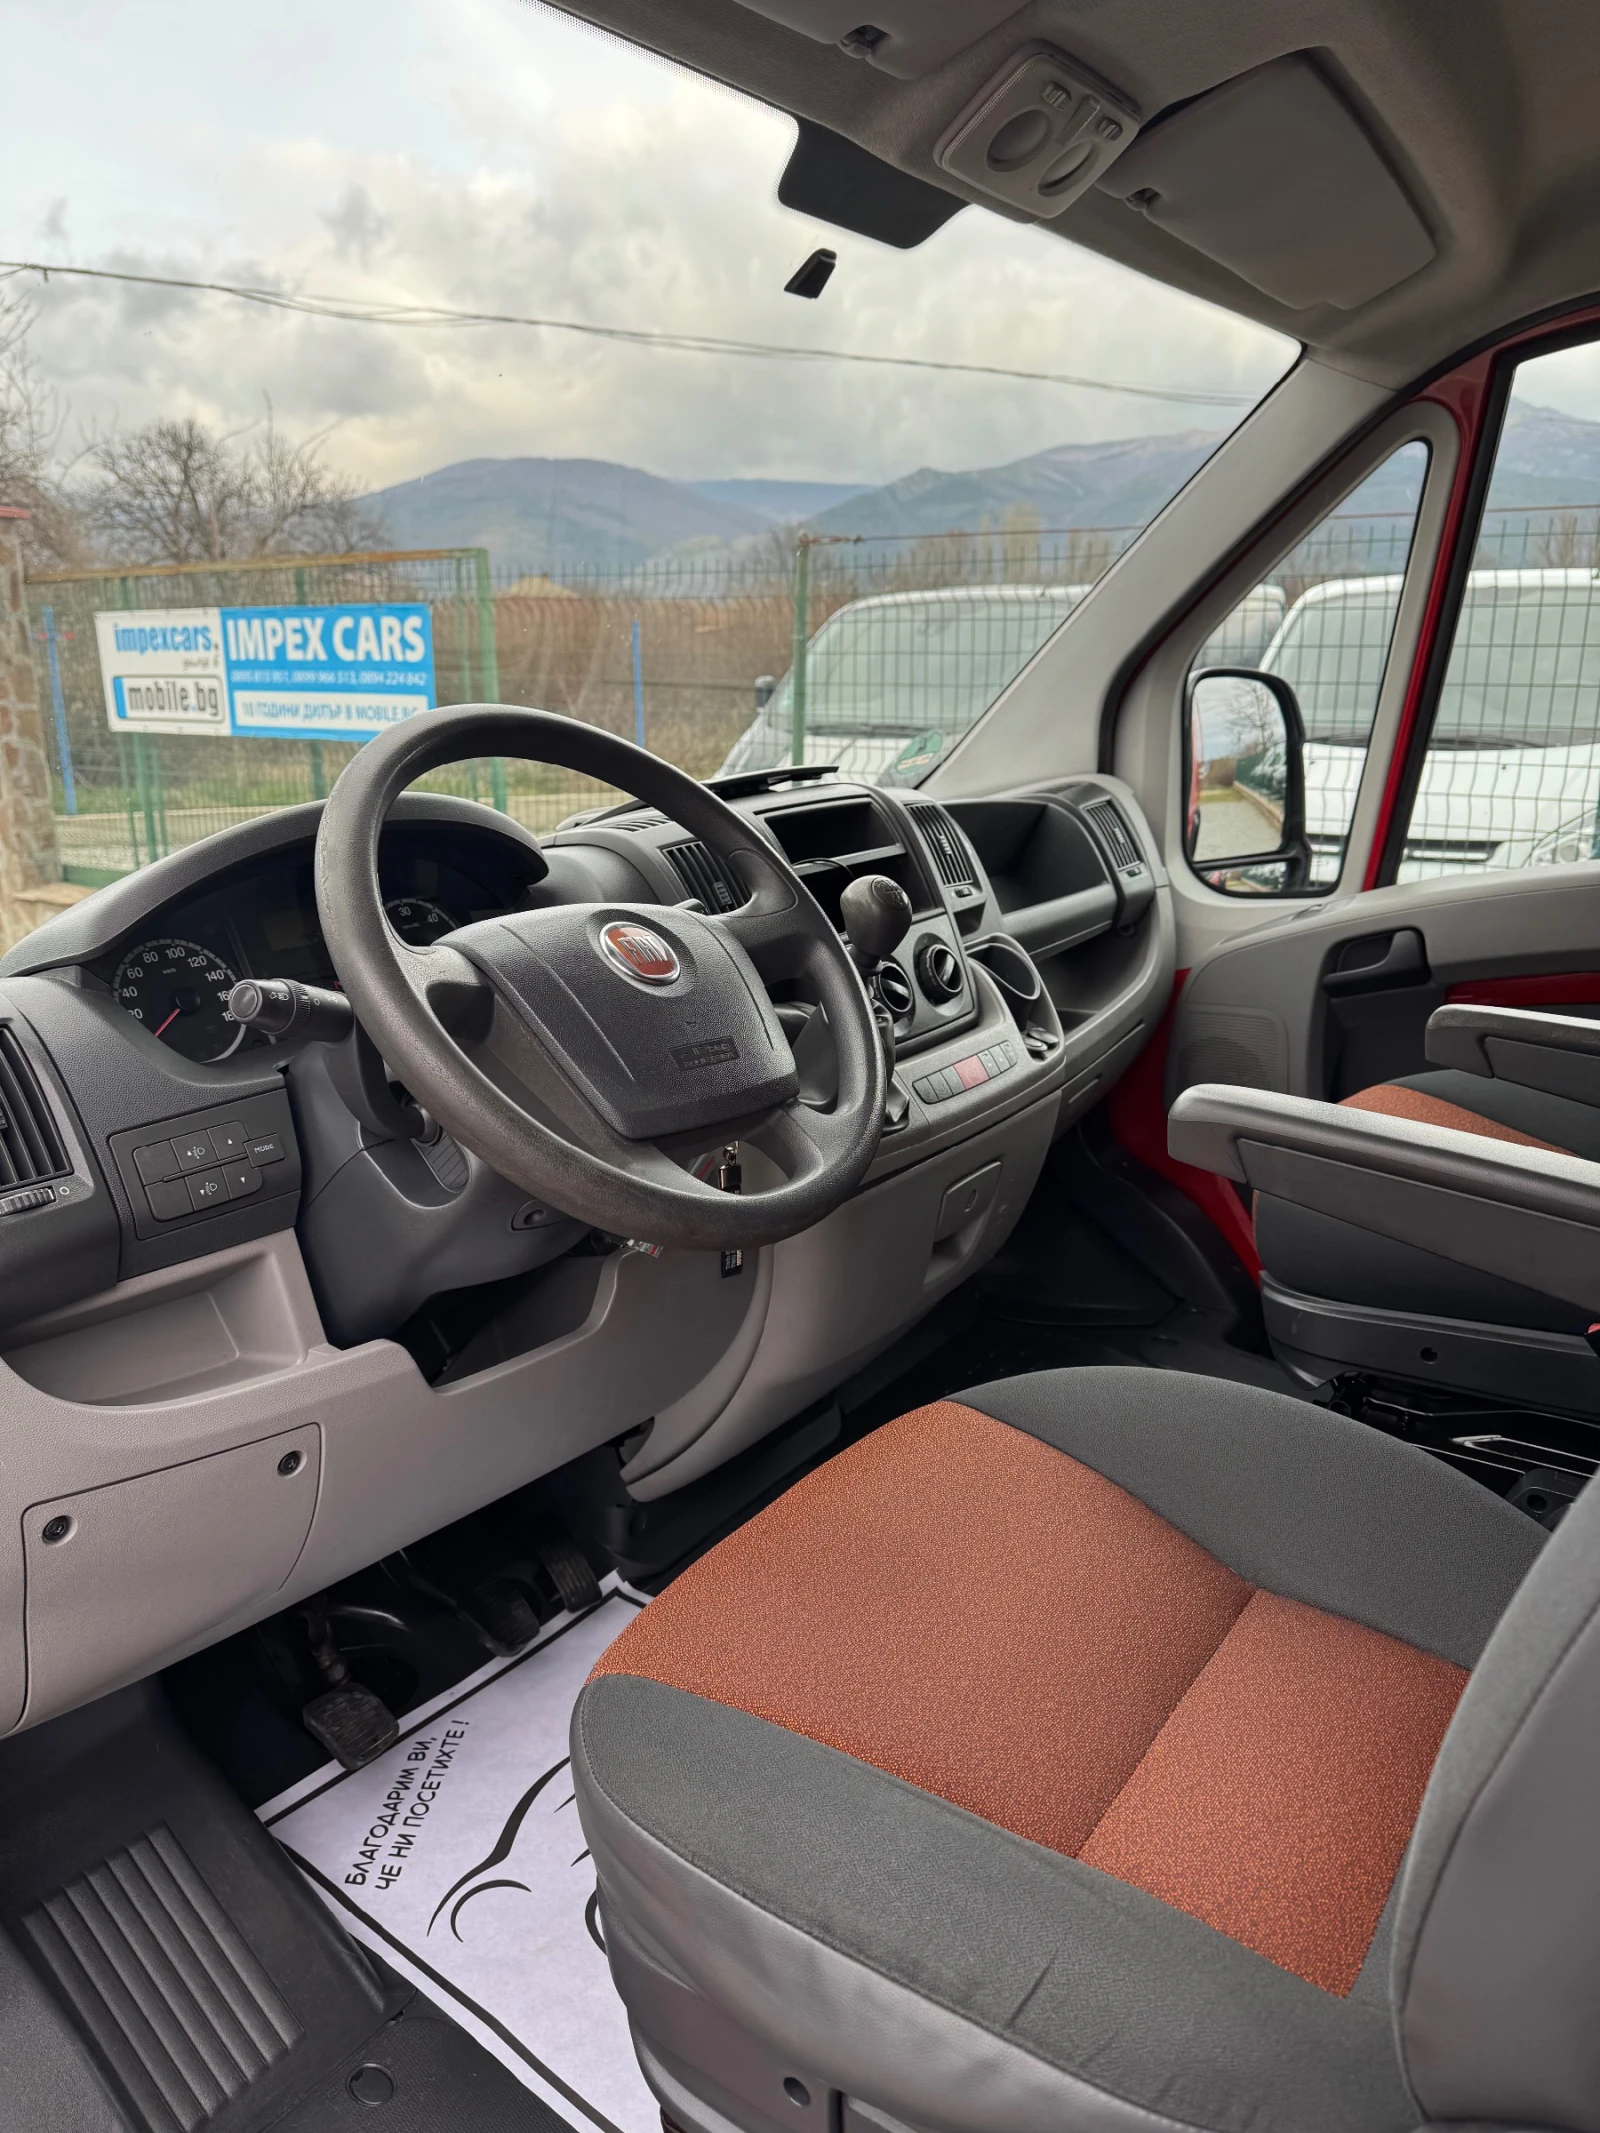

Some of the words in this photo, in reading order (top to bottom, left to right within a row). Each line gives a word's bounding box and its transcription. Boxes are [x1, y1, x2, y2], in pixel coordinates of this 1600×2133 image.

[226, 618, 329, 662] IMPEX
[333, 615, 426, 663] CARS
[128, 681, 219, 717] mobile.bg
[398, 906, 412, 917] 30
[427, 913, 439, 924] 40
[142, 951, 159, 963] 80
[165, 946, 186, 959] 100
[617, 936, 668, 965] FIAT
[187, 955, 207, 968] 120
[126, 967, 143, 979] 60
[205, 969, 225, 982] 140
[122, 986, 138, 998] 40
[254, 1143, 275, 1154] MODE
[344, 1767, 420, 1886] БЛАГОДАРИМ
[407, 1737, 437, 1762] ВИ,
[388, 1833, 416, 1858] НИ
[375, 1864, 402, 1890] ЧЕ
